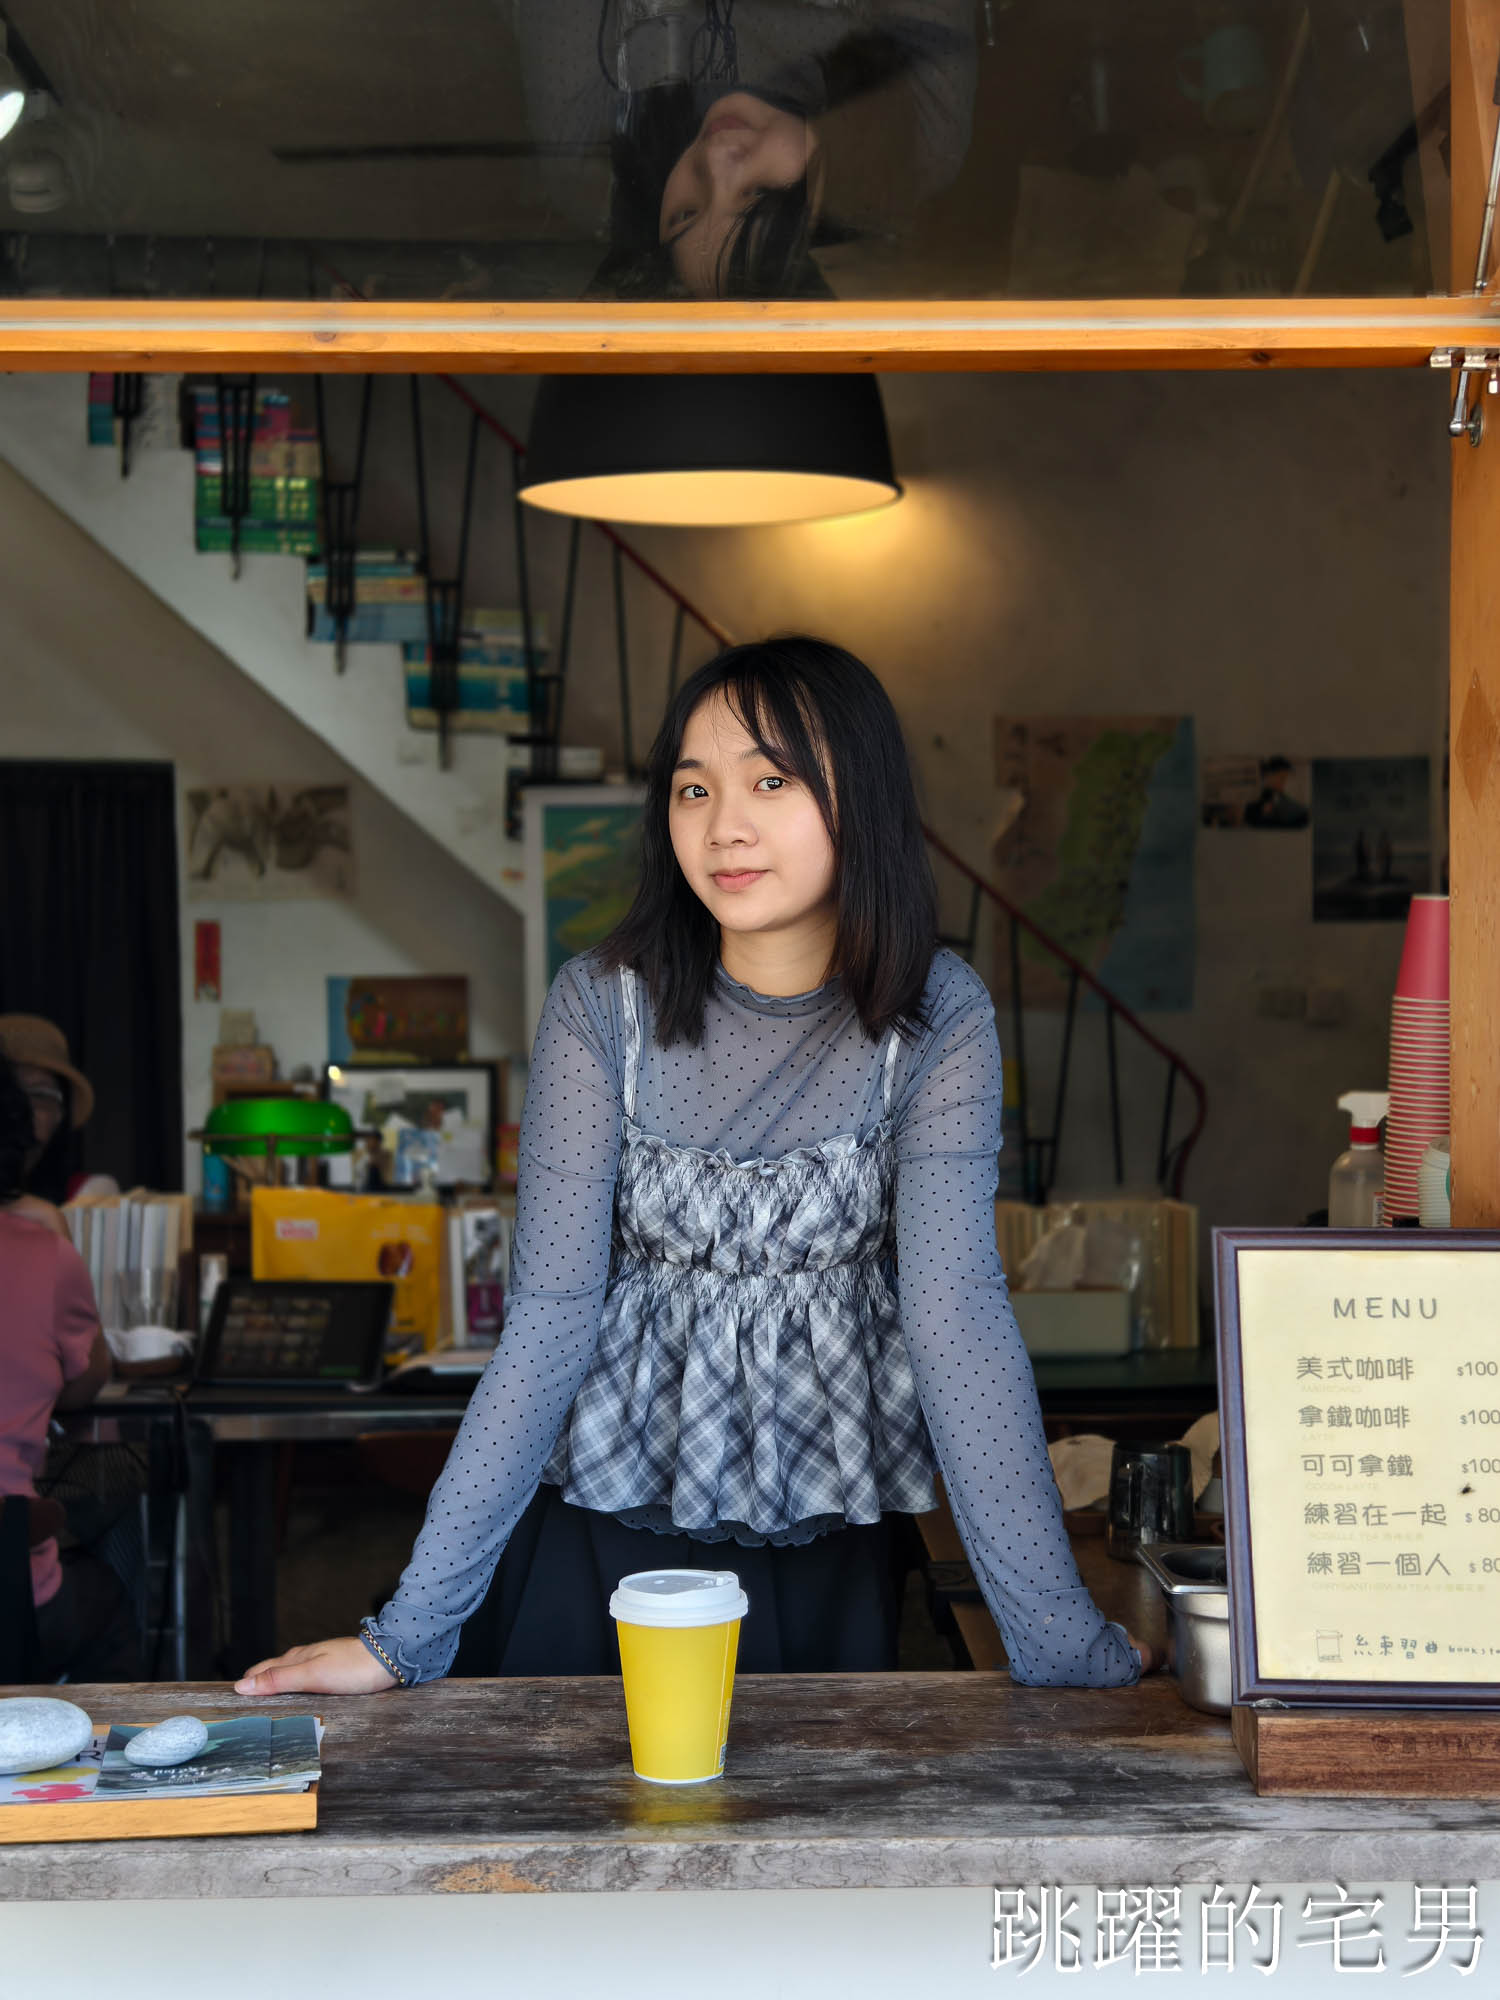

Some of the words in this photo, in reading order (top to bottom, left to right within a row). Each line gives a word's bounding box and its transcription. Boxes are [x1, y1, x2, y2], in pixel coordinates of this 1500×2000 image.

[1333, 1296, 1438, 1320] MENU
[1296, 1356, 1415, 1381] 美式咖啡
[1457, 1360, 1499, 1377] $100
[1298, 1404, 1411, 1429] 拿鐵咖啡
[1460, 1409, 1500, 1425] $100
[1300, 1453, 1414, 1478] 可可拿鐵
[1461, 1458, 1500, 1474] $100
[1304, 1502, 1448, 1527] 練習在一起
[1306, 1551, 1451, 1577] 練習一個人
